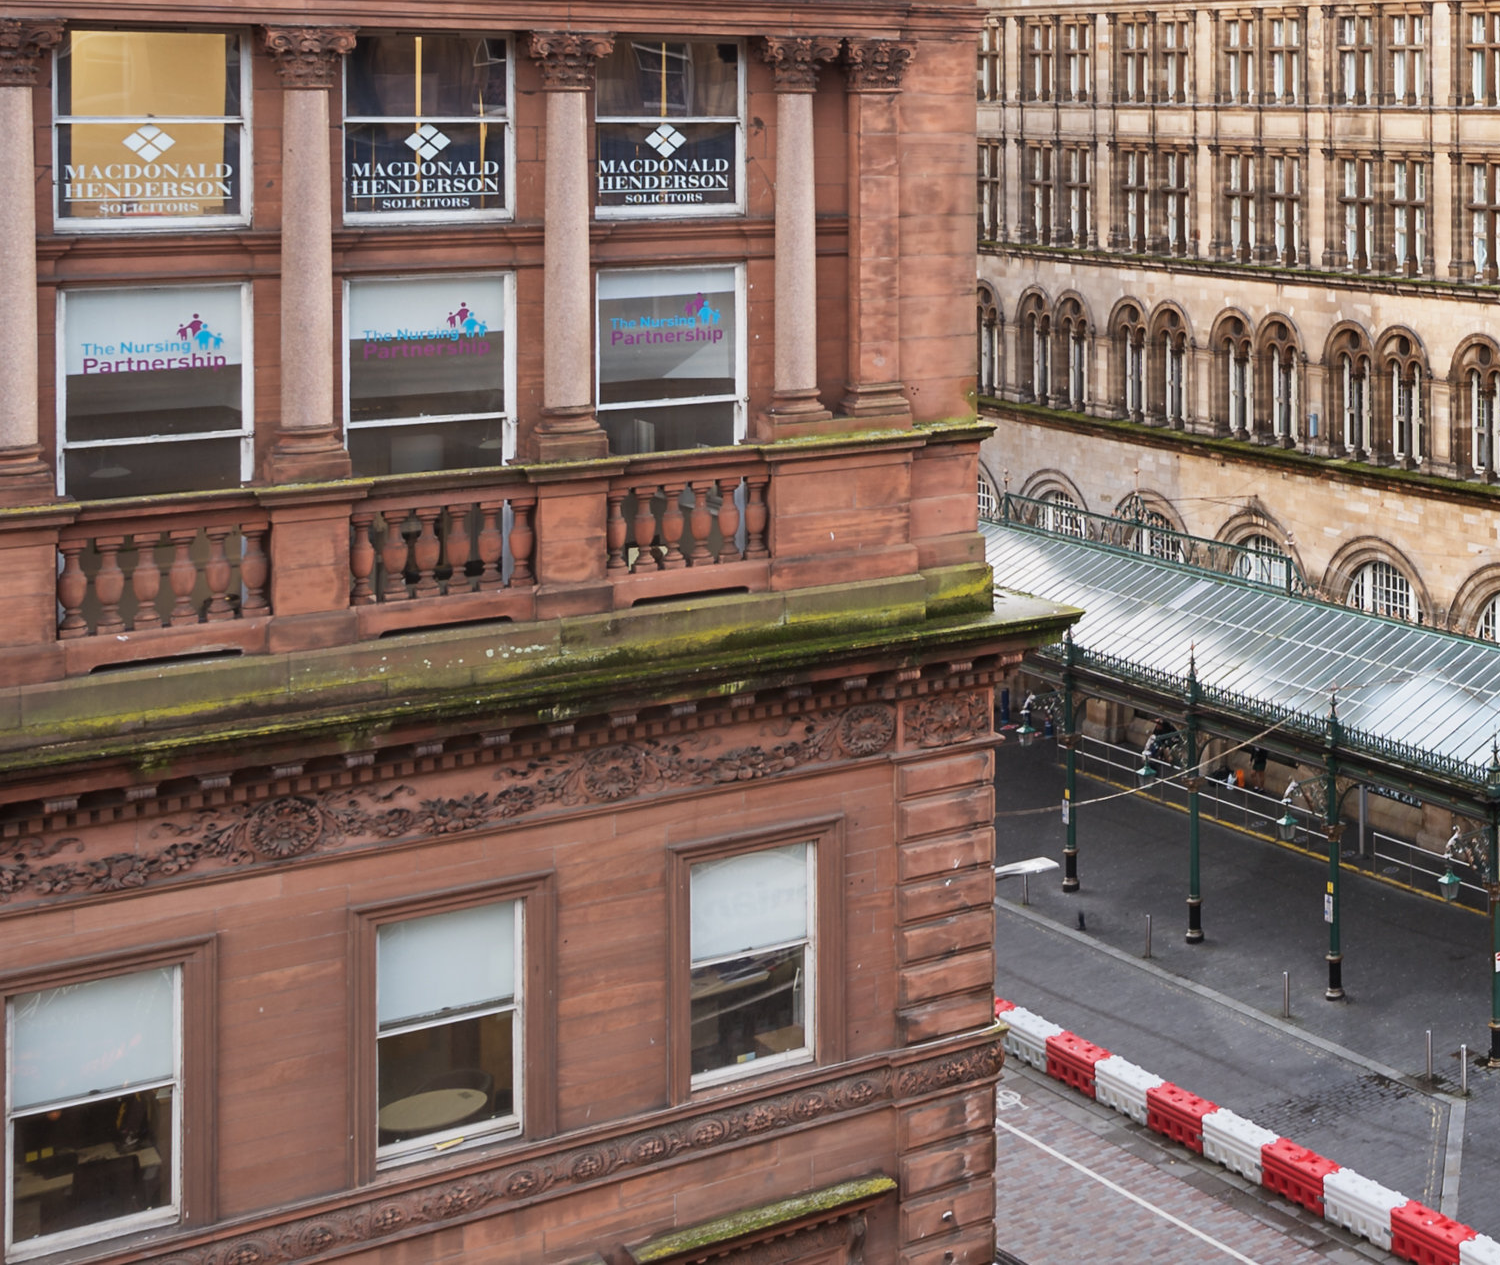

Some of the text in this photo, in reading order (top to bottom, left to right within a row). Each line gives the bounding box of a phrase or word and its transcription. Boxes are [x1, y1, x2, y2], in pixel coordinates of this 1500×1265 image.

[64, 163, 233, 180] MACDONALD
[351, 161, 500, 177] MACDONALD
[599, 159, 729, 174] MACDONALD
[351, 177, 499, 194] HENDERSON
[599, 174, 728, 189] HENDERSON
[64, 181, 233, 199] HENDERSON
[625, 192, 703, 204] SOLICITORS
[99, 202, 199, 214] SOLICITORS
[382, 197, 470, 209] SOLICITORS
[609, 315, 697, 329] The Nursing
[363, 327, 459, 343] The Nursing
[610, 326, 723, 346] Partnership
[81, 340, 191, 356] The Nursing
[363, 338, 491, 360] Partnership
[82, 352, 227, 375] Partnership
